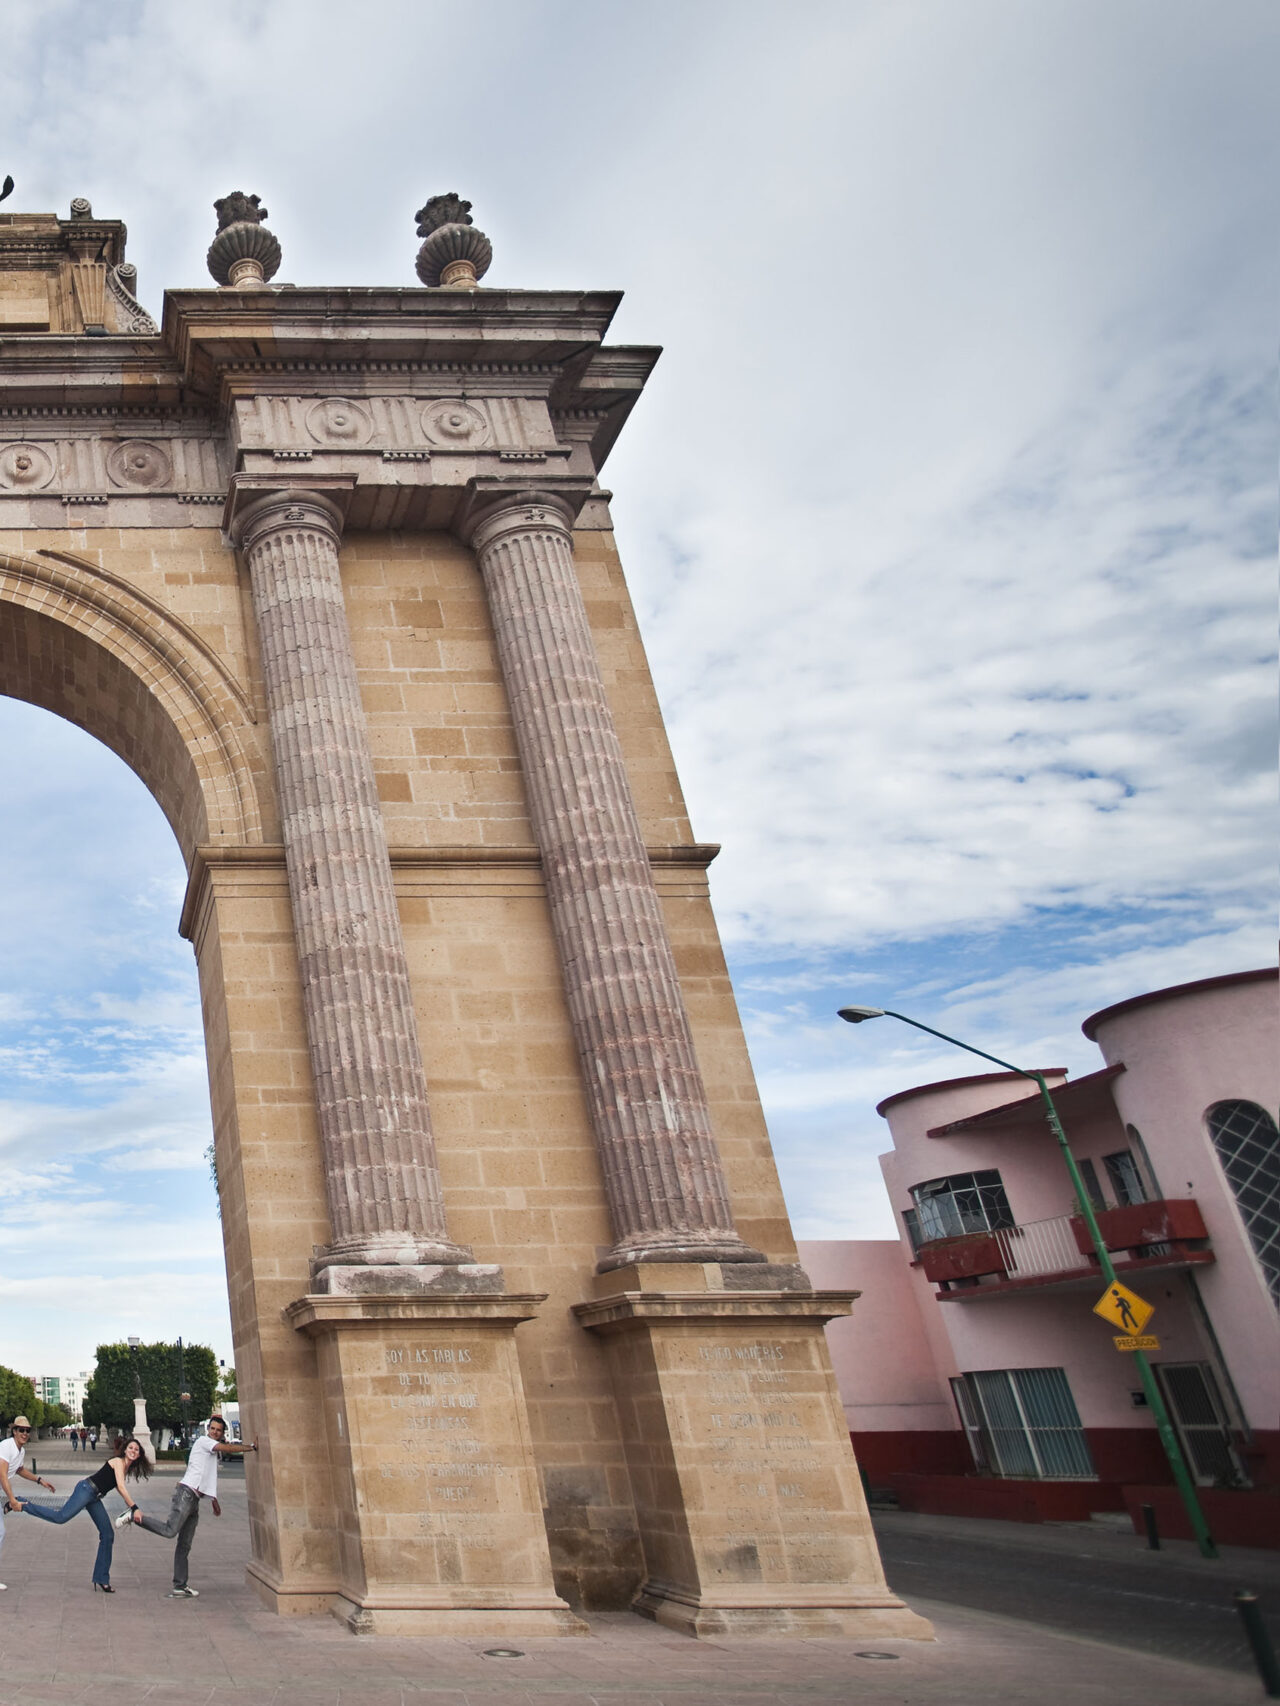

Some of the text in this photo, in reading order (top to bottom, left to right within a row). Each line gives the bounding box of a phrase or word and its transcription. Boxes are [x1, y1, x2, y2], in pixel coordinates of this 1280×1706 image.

[385, 1349, 472, 1364] SOY LAS TABLAS
[735, 1346, 784, 1361] MADERAS
[400, 1372, 412, 1386] DE
[435, 1487, 477, 1501] PUERT
